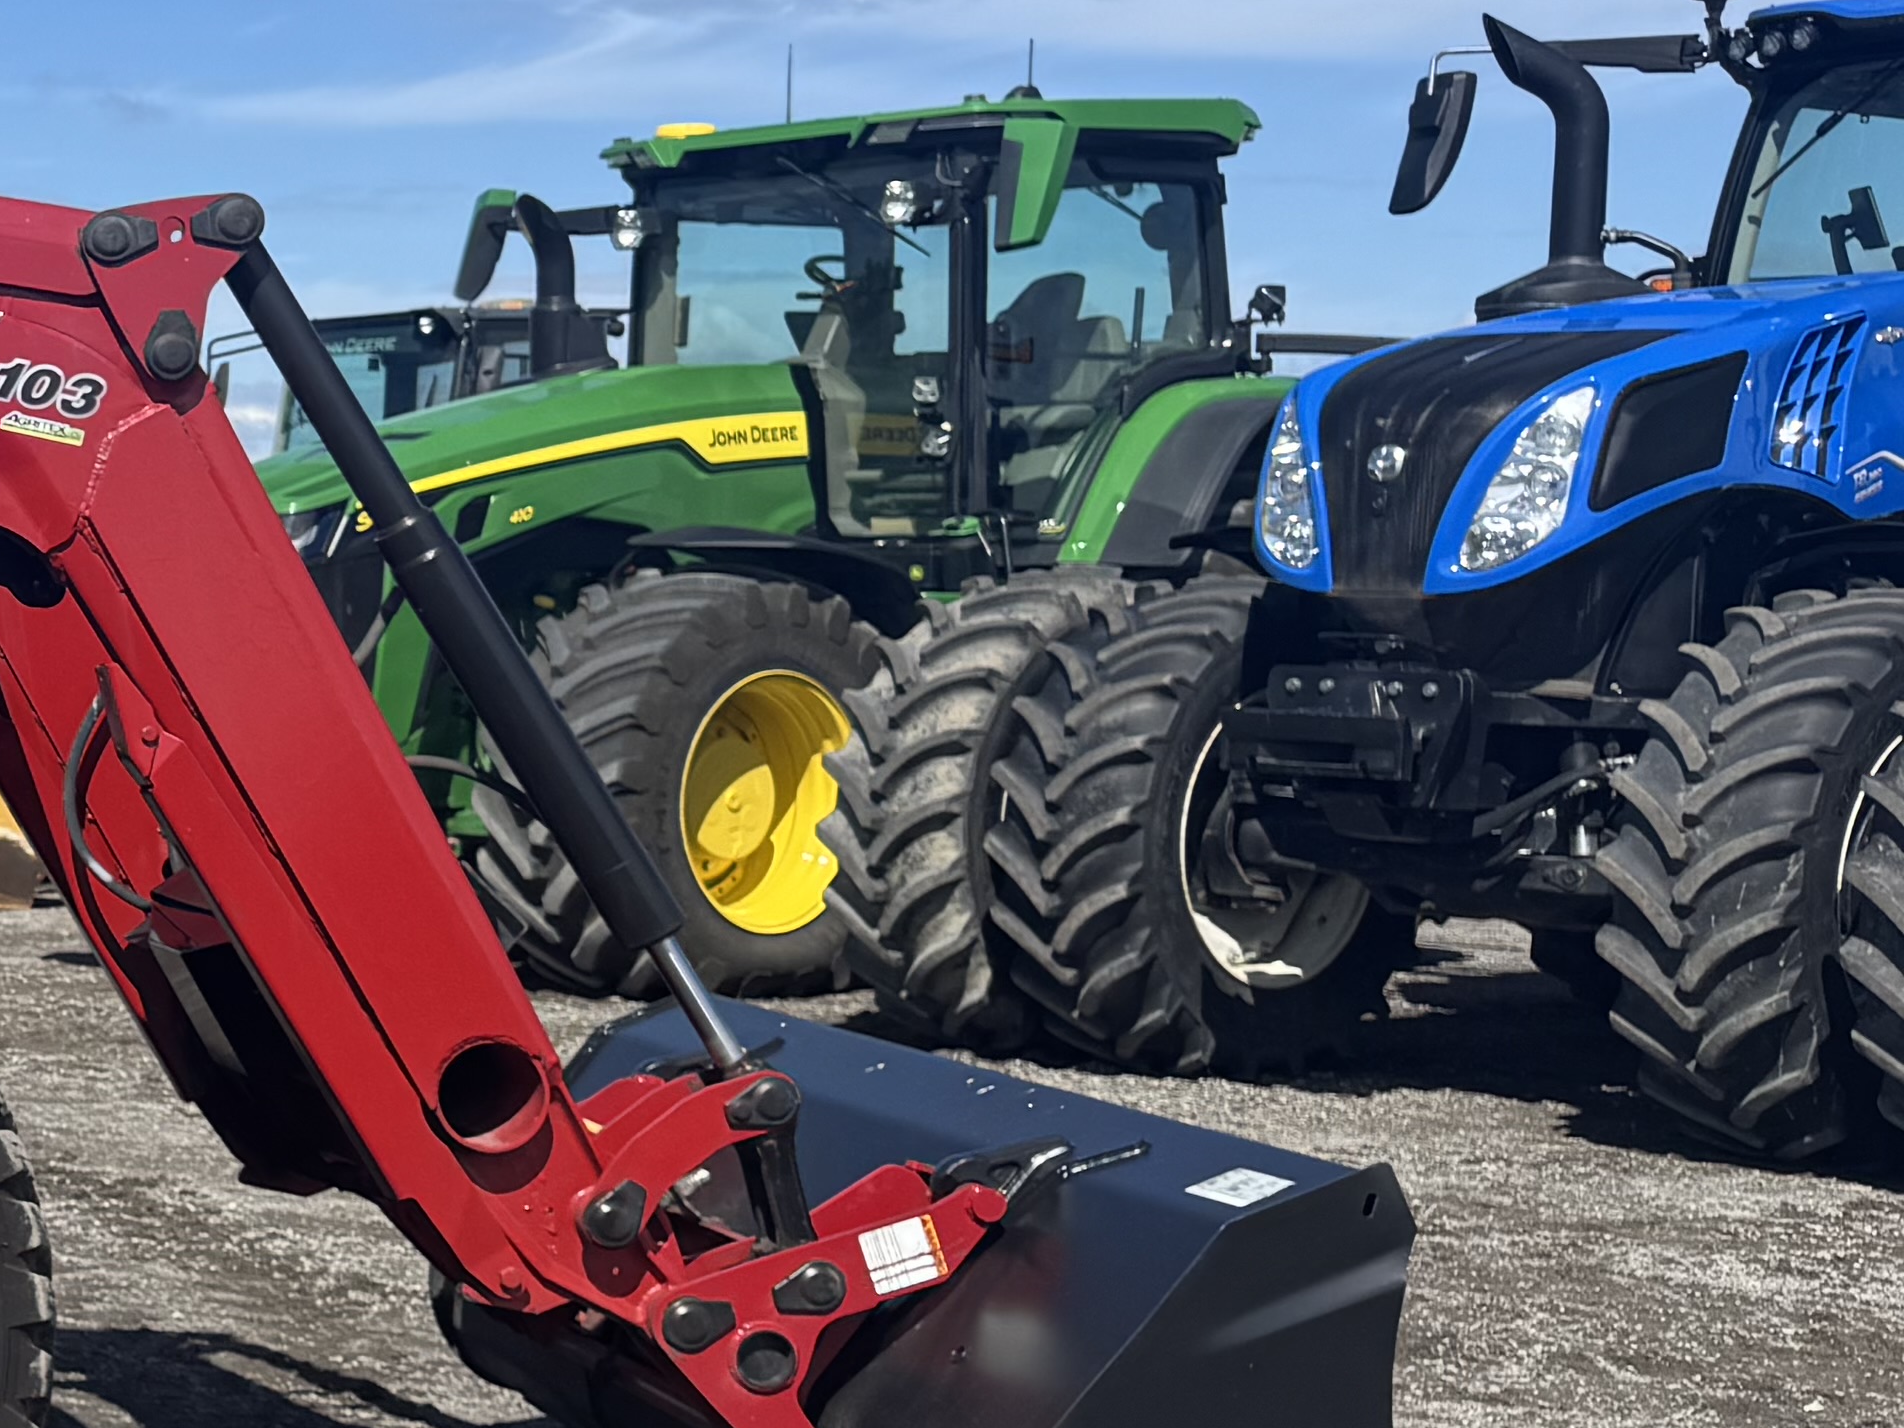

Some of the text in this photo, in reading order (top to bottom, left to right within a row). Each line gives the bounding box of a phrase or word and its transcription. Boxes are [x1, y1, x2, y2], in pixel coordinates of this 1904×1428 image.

[6, 413, 67, 438] AGRITEX
[708, 424, 799, 448] JOHN DEERE
